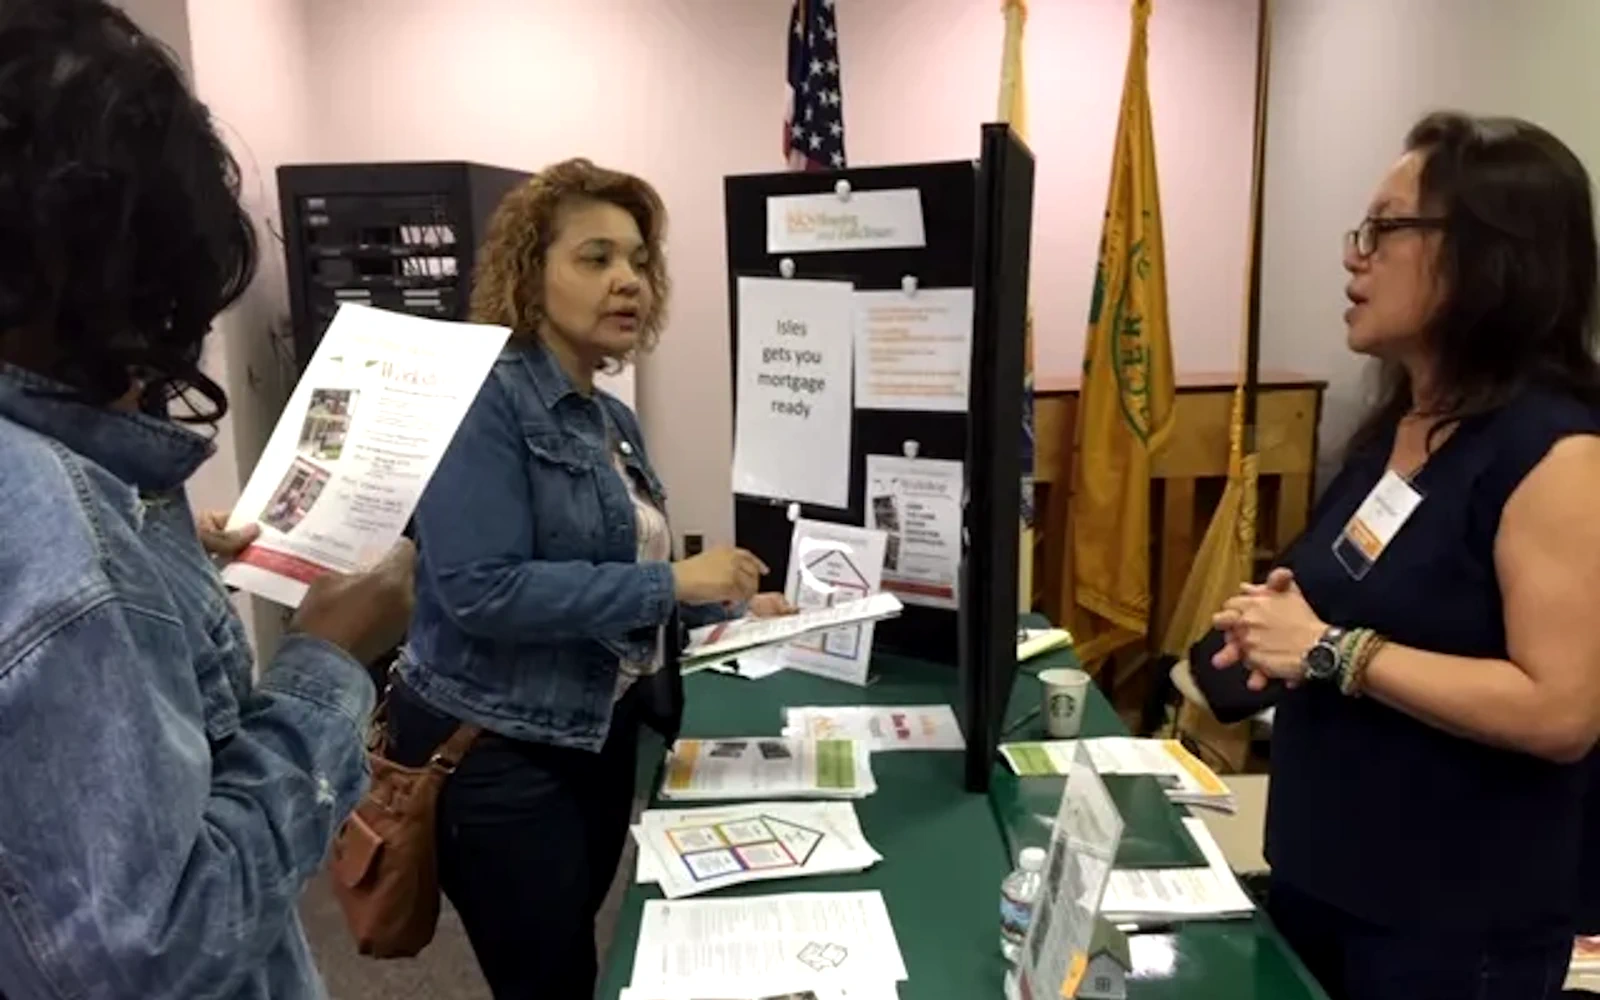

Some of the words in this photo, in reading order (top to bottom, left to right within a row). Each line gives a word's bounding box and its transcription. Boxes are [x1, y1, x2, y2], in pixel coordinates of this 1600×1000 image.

[776, 319, 807, 336] Isles
[762, 347, 791, 364] gets
[795, 350, 822, 367] you
[757, 374, 825, 394] mortgage
[771, 399, 810, 419] ready
